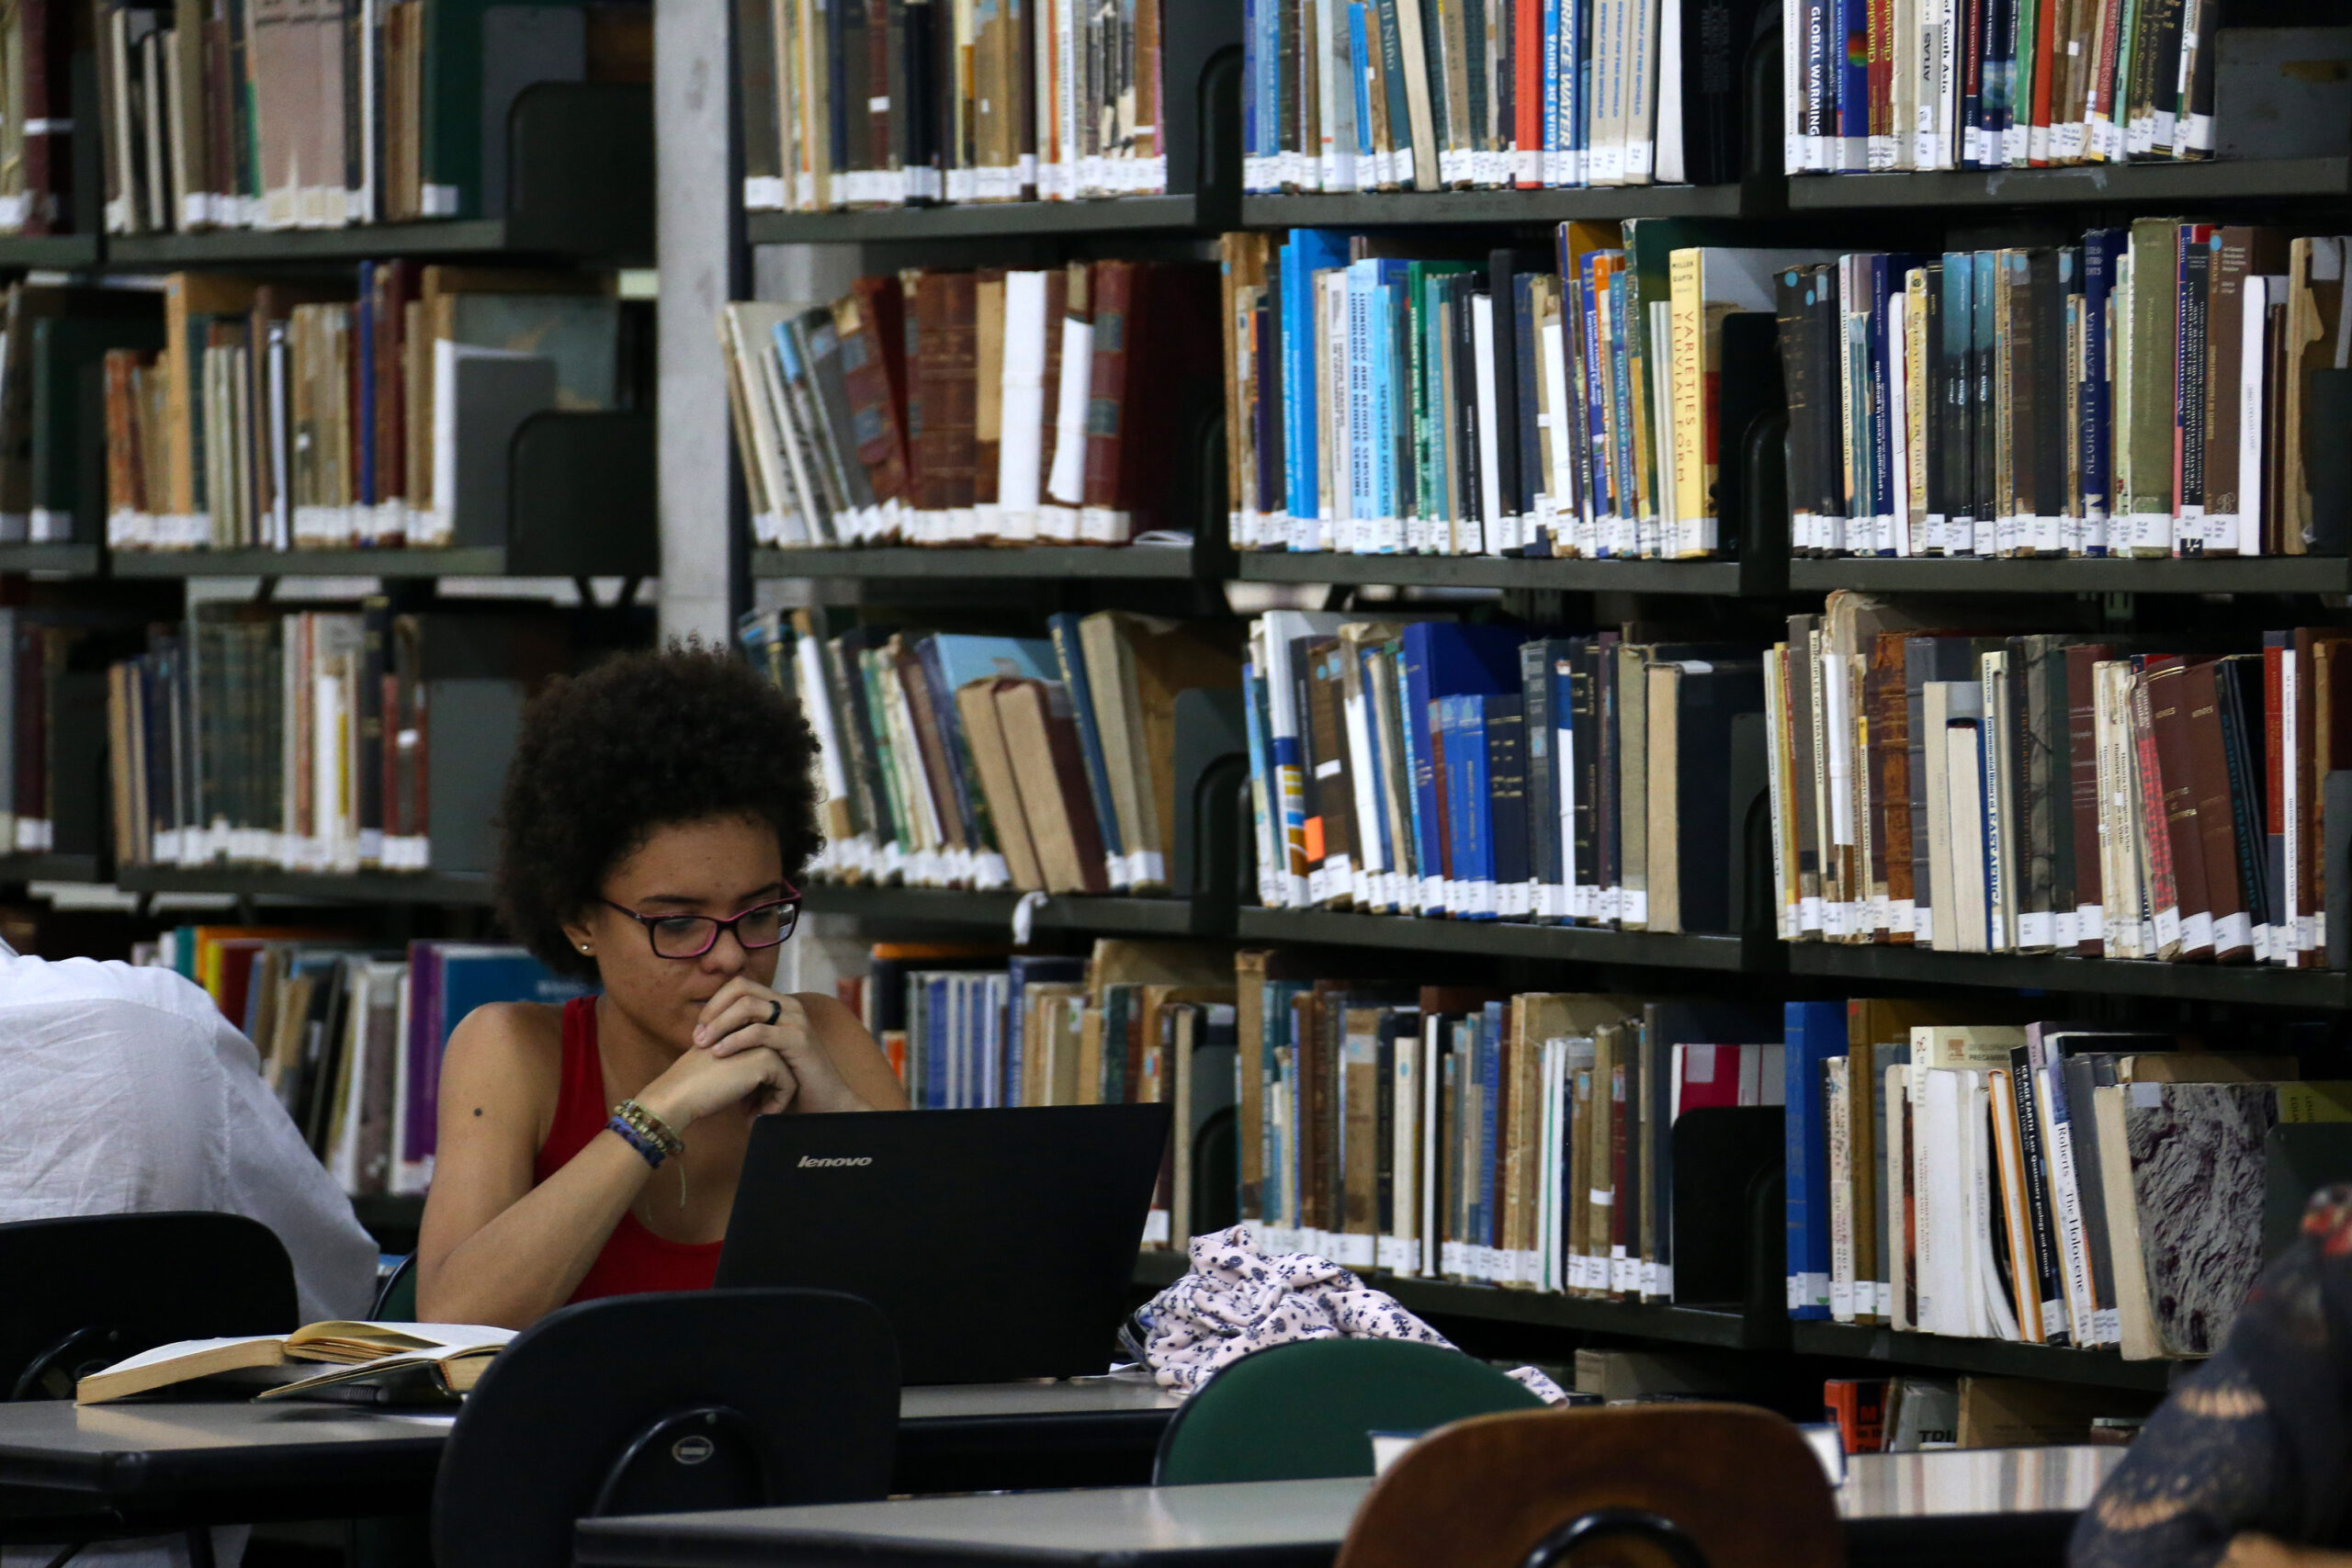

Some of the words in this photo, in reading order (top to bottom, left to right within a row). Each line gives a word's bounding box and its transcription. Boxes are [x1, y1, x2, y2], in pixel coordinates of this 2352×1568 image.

[1810, 6, 1821, 62] GLOBAL
[1942, 18, 1951, 59] South
[1547, 34, 1556, 79] CHUVA
[1923, 33, 1931, 82] ATLAS
[1547, 85, 1556, 100] DE
[1809, 64, 1821, 136] WARMING
[1941, 64, 1950, 94] Asia
[1560, 73, 1572, 145] WATER
[1616, 351, 1625, 393] FLUVIAL
[1674, 313, 1684, 402] FLUVIAL
[1684, 310, 1696, 427] VARIETIES
[1589, 374, 1599, 406] Change
[1957, 378, 1966, 405] Clima
[1979, 375, 1988, 402] Clima
[1352, 395, 1361, 442] REMOTE
[1618, 396, 1626, 432] FORMS
[1675, 421, 1685, 483] FORM
[1686, 440, 1694, 455] of
[2086, 401, 2096, 474] NEGRETTI
[1363, 447, 1371, 497] SENSING
[1621, 446, 1630, 502] PROCESSES
[1814, 696, 1821, 710] OF
[1815, 714, 1824, 785] STRATIGRAPHY
[1986, 716, 1996, 772] Environmental
[1987, 773, 1996, 799] History
[1989, 812, 1998, 851] EAST
[2222, 714, 2240, 792] MAGNETIC
[2233, 798, 2258, 911] STRATIGRAPHY
[1991, 854, 1999, 907] AFRICA
[2021, 1065, 2030, 1080] ICE
[2023, 1081, 2031, 1100] AGE
[2025, 1101, 2034, 1132] EARTH
[797, 1156, 873, 1168] lenovo
[2029, 1134, 2037, 1153] Late
[2058, 1126, 2073, 1178] Roberts
[2030, 1155, 2041, 1200] Quaternary
[2035, 1201, 2045, 1231] geology
[2065, 1190, 2075, 1214] The
[2042, 1249, 2051, 1279] climate
[2069, 1218, 2085, 1293] Holocene
